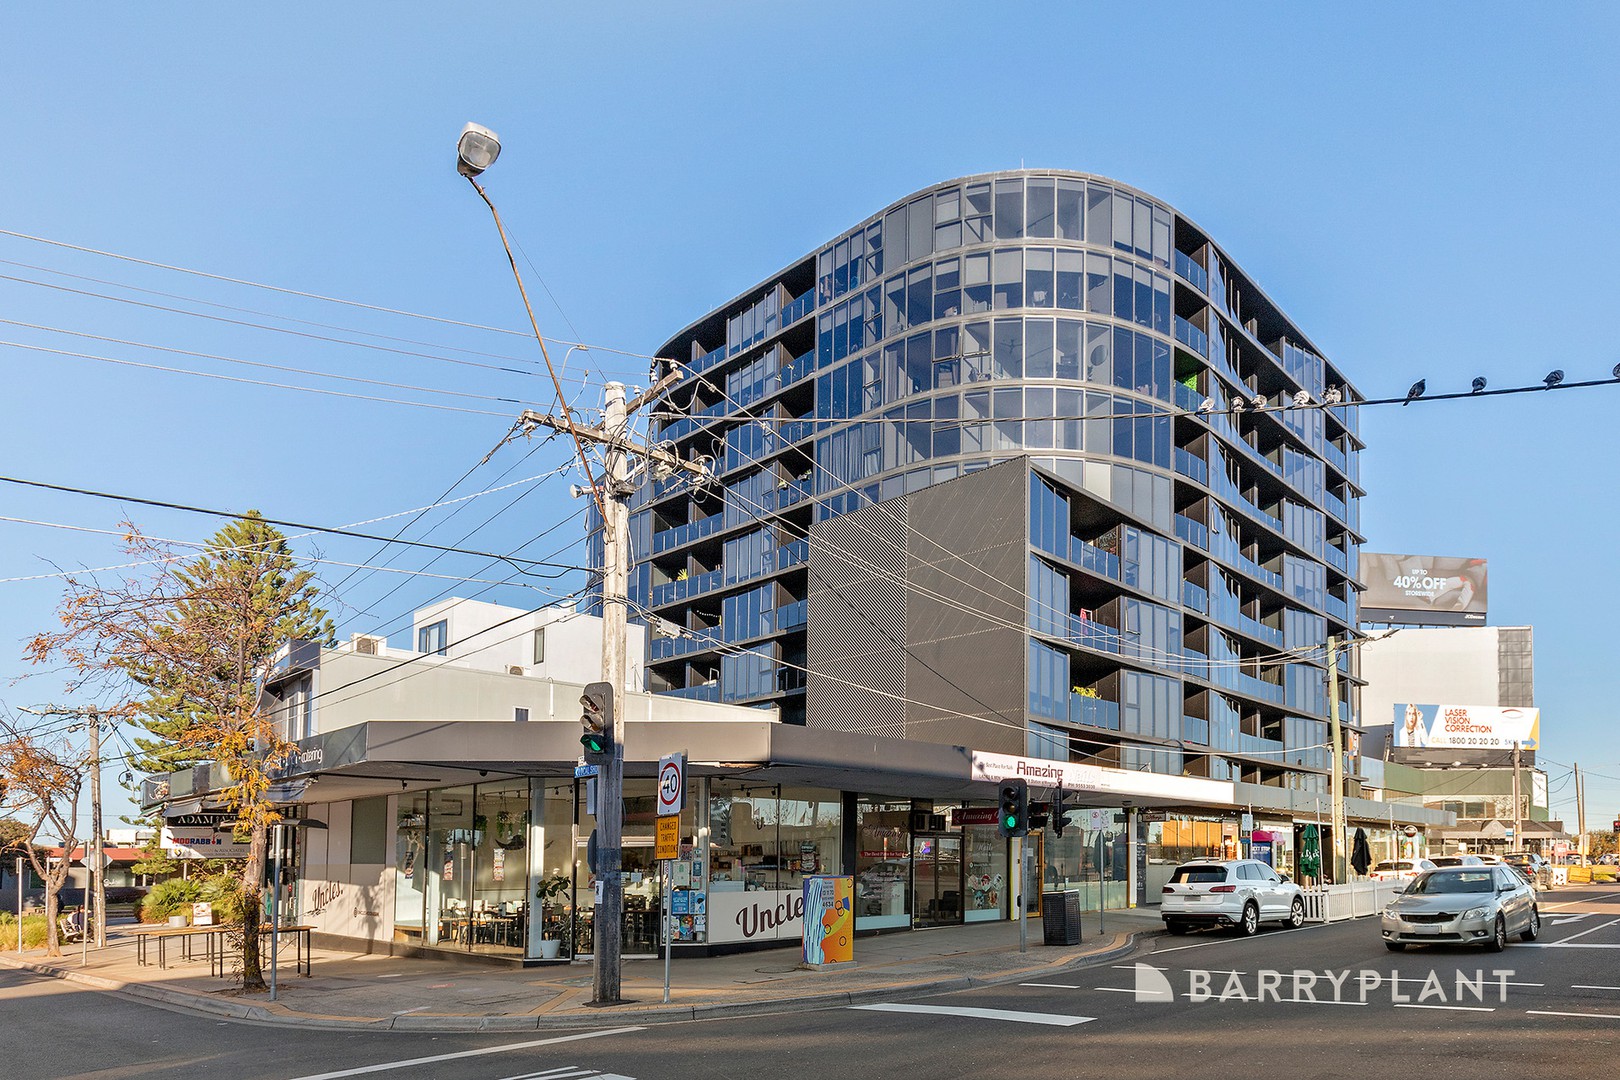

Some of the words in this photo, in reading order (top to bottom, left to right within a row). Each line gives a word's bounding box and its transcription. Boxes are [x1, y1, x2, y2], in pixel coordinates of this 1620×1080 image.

[1393, 576, 1421, 589] 40%
[1422, 577, 1447, 590] OFF
[1444, 708, 1467, 716] LASER
[1444, 717, 1471, 725] VISION
[1444, 725, 1493, 733] CORRECTION
[1449, 737, 1466, 745] 1800
[1468, 737, 1477, 745] 20
[1490, 738, 1500, 746] 20
[1016, 761, 1064, 782] Amazing
[662, 774, 678, 794] 40
[177, 815, 213, 824] ADAM
[660, 821, 677, 831] CHANGED
[660, 833, 675, 842] TRAFFIC
[657, 845, 678, 854] CONDITIONS
